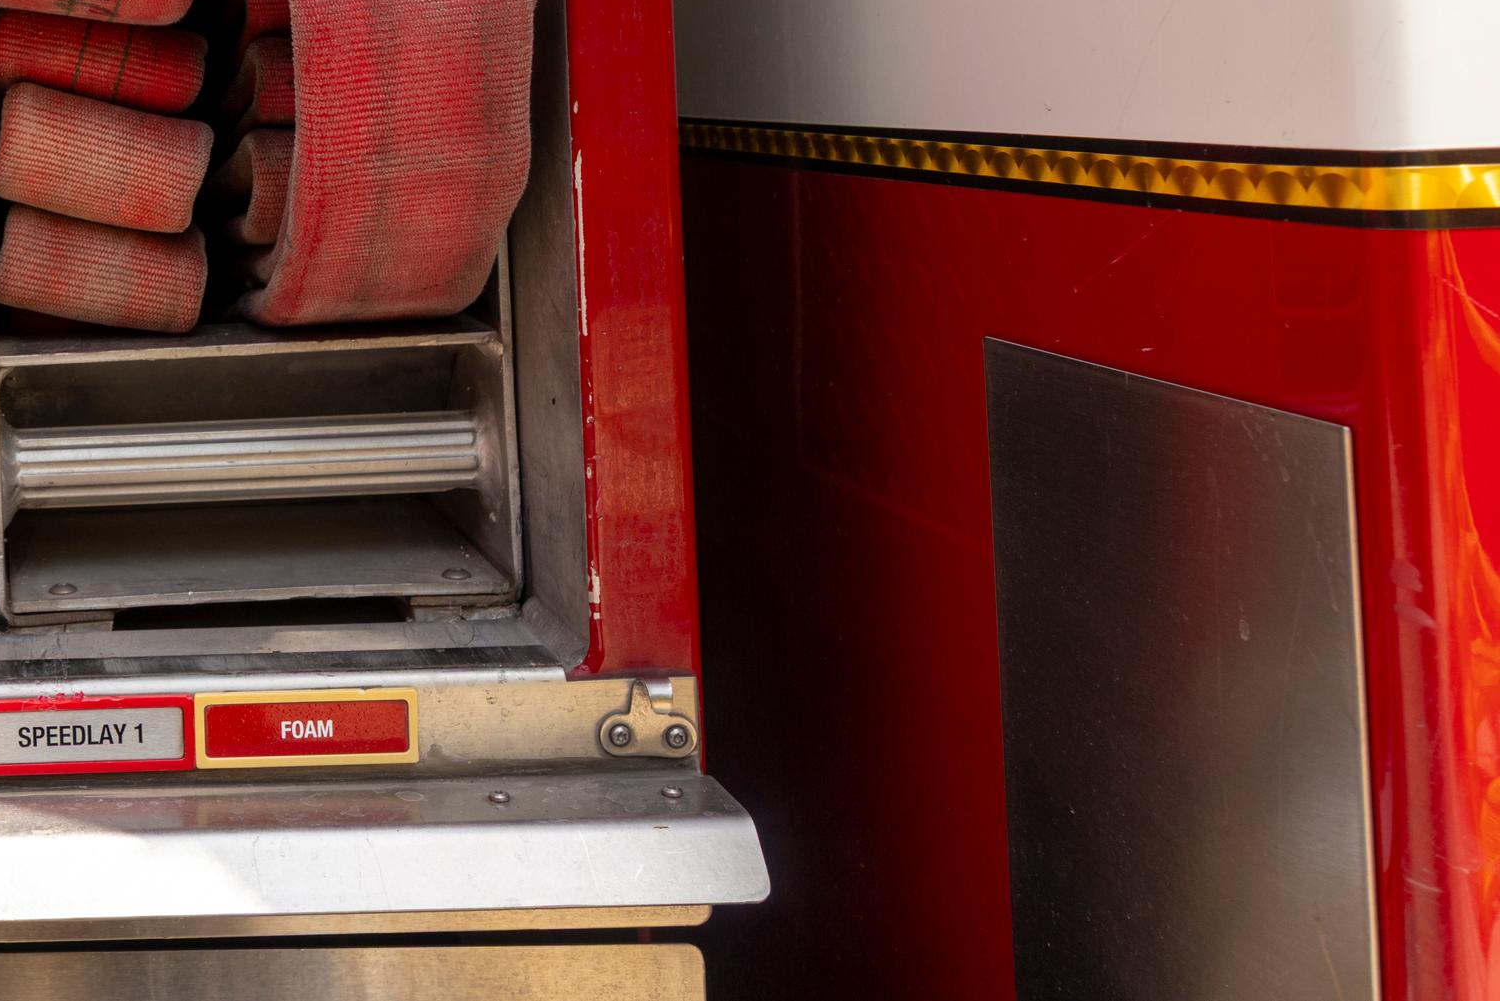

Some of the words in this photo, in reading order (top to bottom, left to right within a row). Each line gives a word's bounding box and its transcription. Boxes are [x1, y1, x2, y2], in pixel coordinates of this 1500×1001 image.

[18, 723, 127, 748] SPEEDLAY
[134, 723, 144, 744] 1
[280, 719, 334, 739] FOAM
